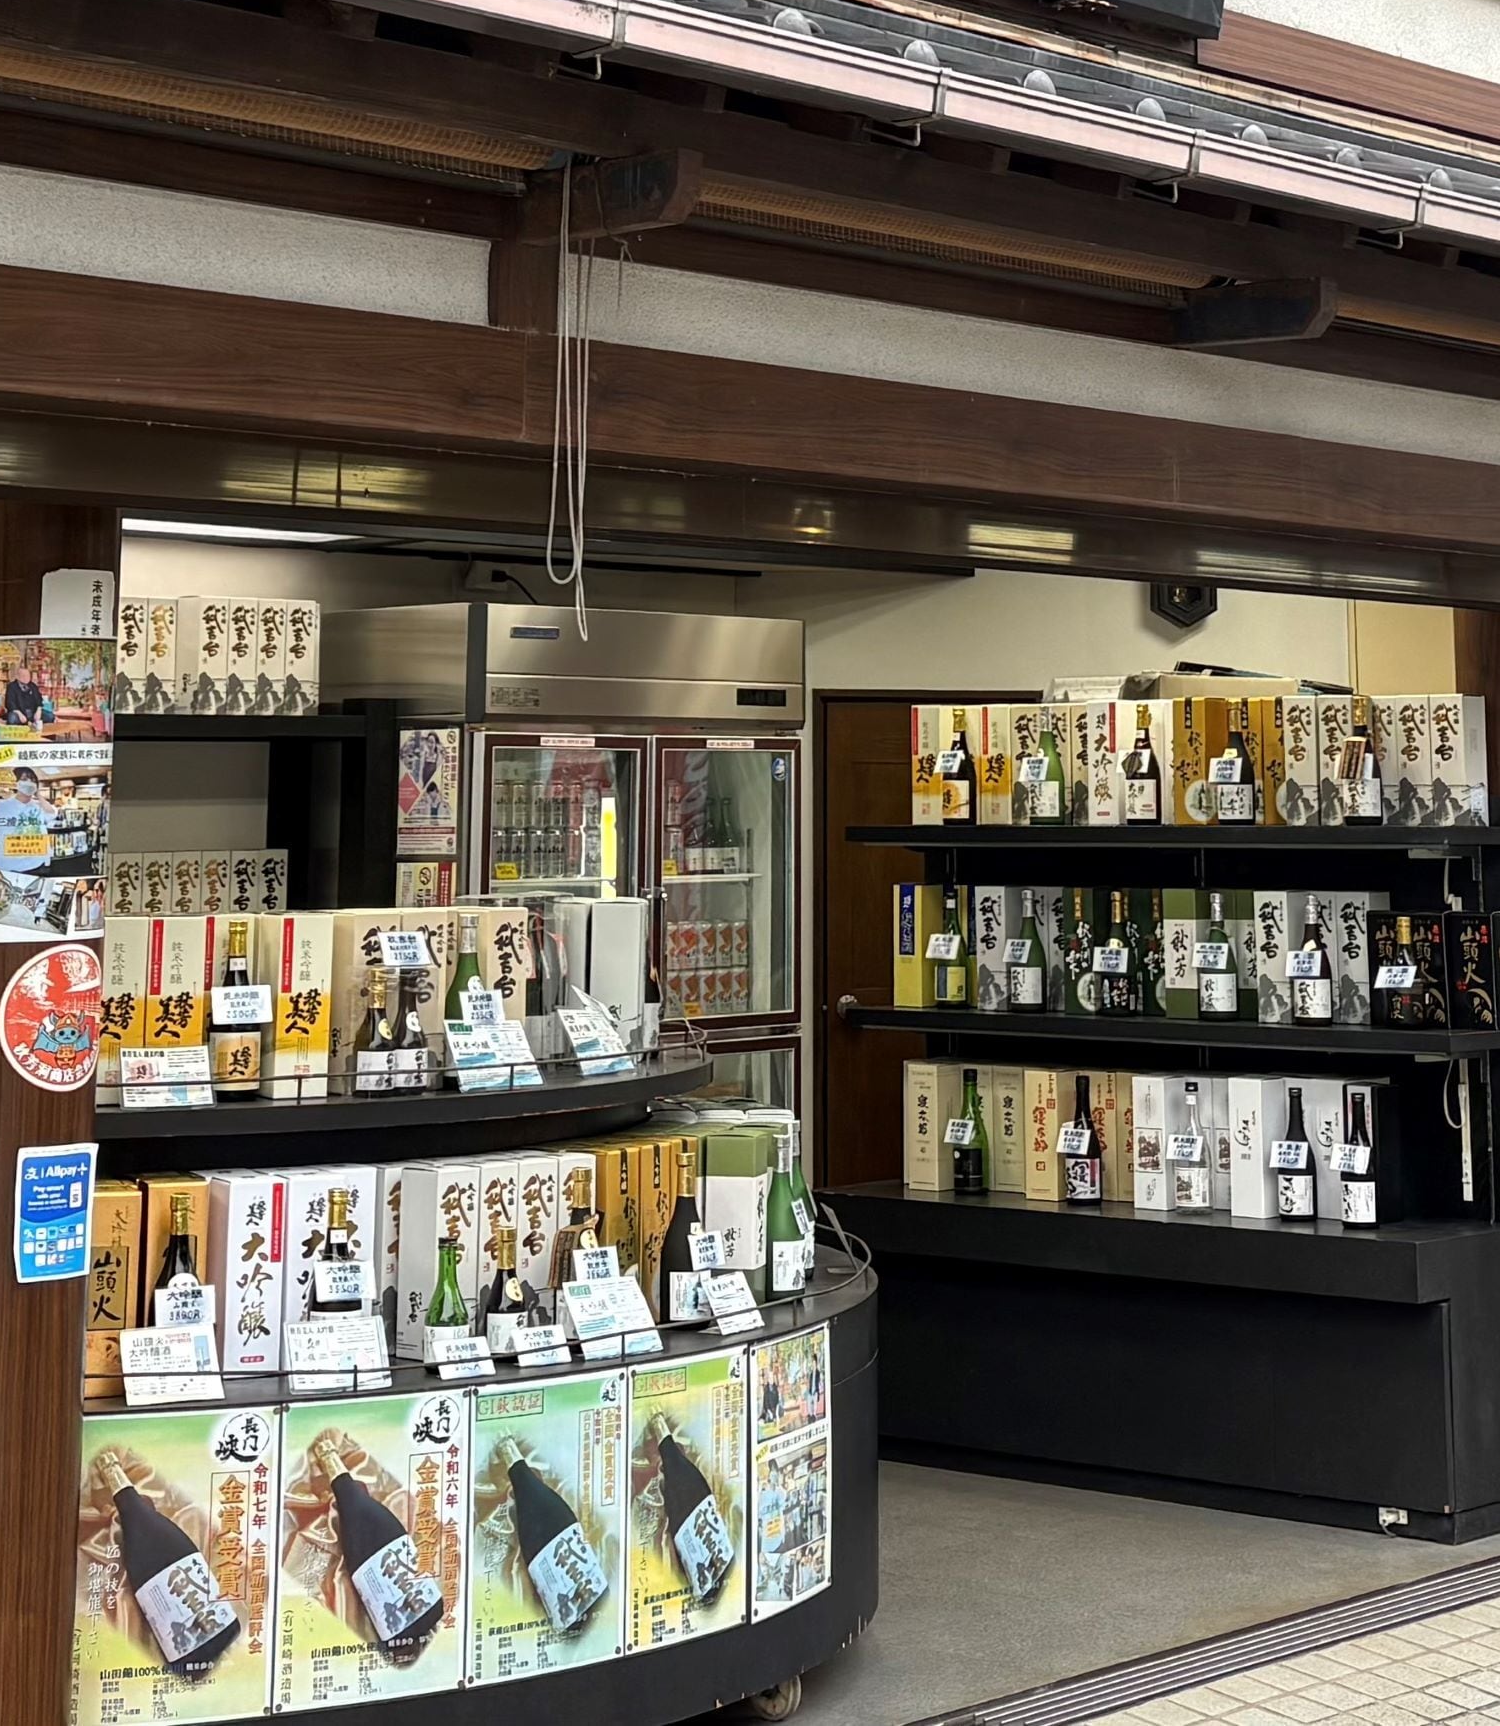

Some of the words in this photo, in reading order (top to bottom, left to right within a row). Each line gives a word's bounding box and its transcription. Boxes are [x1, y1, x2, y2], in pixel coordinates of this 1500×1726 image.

[1286, 703, 1311, 762] 秋吉台
[1398, 703, 1424, 763] 秋吉台
[1432, 703, 1457, 762] 秋吉台
[980, 896, 1001, 950] 秋吉台
[1259, 901, 1282, 959] 秋吉台
[1340, 901, 1364, 960] 秋吉台
[300, 939, 312, 981] 純米吟醸
[494, 921, 523, 999] 秋吉台
[1170, 930, 1188, 979] 秋芳
[1460, 924, 1486, 985] 山頭火
[285, 988, 322, 1035] 秋芳美人
[522, 1173, 551, 1257] 秋吉台
[92, 1251, 122, 1323] 山頭火
[236, 1232, 274, 1347] 大吟醸
[413, 1400, 452, 1443] 長門峡
[477, 1390, 543, 1416] GI萩認証
[215, 1417, 259, 1462] 長門峡
[252, 1463, 268, 1529] 令和七年
[445, 1443, 460, 1509] 令和六年
[217, 1474, 247, 1599] 金賞受賞
[415, 1456, 441, 1578] 金賞受賞
[106, 1545, 121, 1611] 匠の技を
